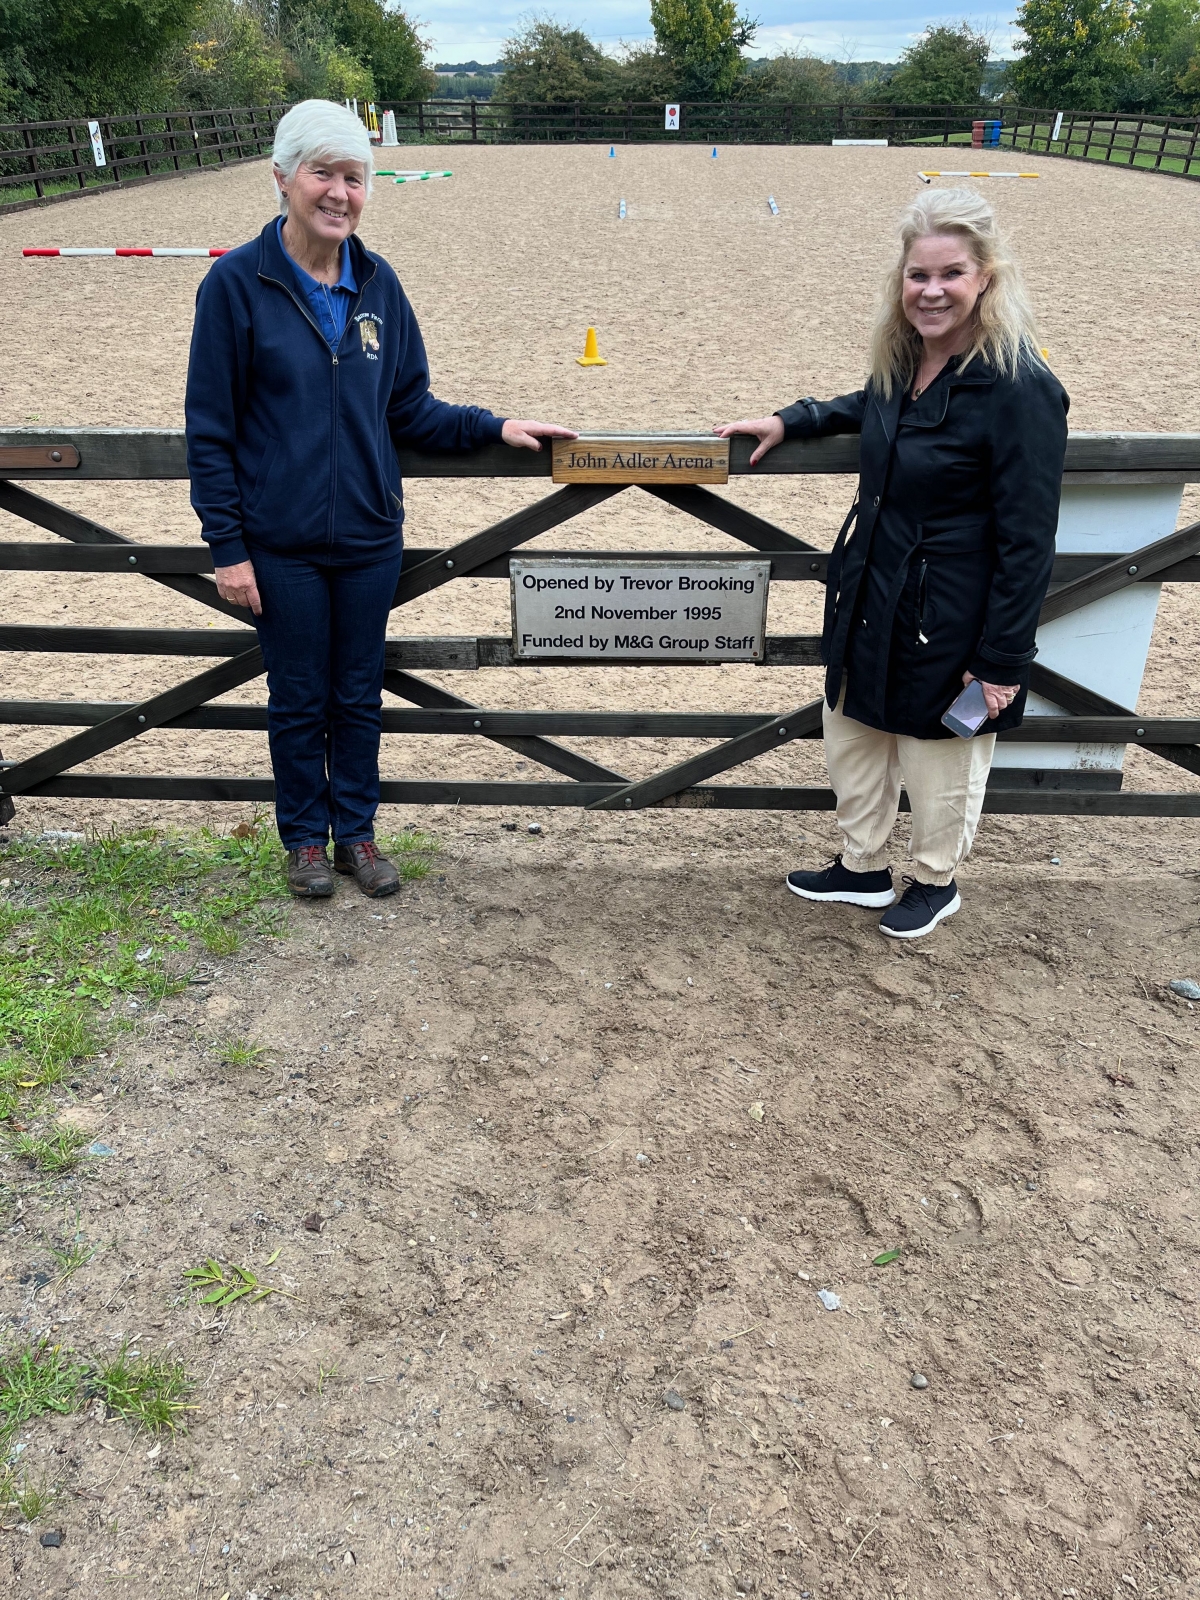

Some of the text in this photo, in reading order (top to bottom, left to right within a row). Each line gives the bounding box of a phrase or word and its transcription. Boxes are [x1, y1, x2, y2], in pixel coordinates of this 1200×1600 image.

[669, 119, 676, 127] A
[568, 452, 714, 470] John Adler Arena
[522, 574, 755, 594] Opened by Trevor Brooking
[554, 605, 722, 621] 2nd November 1995
[522, 633, 755, 653] Funded by M&G Group Staff
